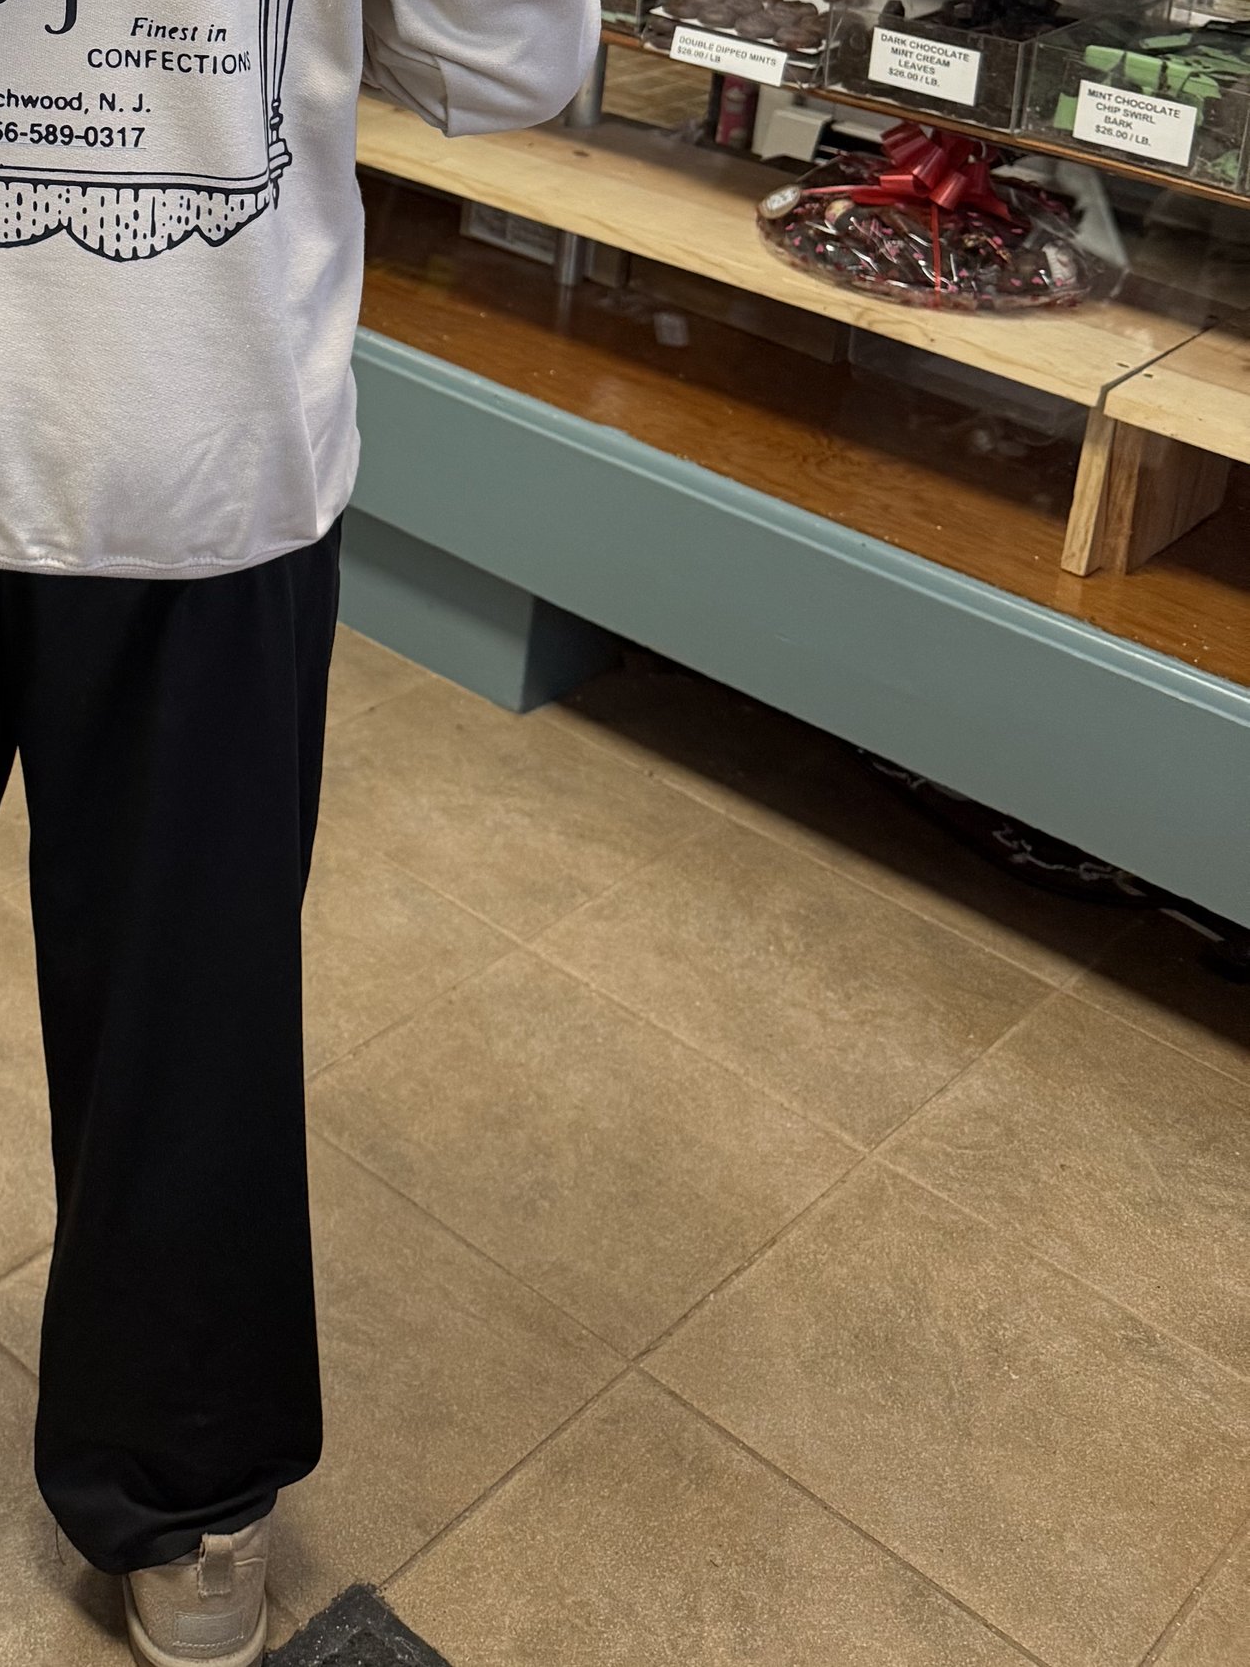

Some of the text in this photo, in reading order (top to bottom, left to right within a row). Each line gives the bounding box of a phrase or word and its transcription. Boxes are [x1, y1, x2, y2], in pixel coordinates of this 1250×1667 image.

[130, 17, 228, 42] Finest in
[679, 35, 777, 66] DOUBLE DIPPED MINTS
[880, 32, 970, 62] DARK CHOCOLATE
[890, 47, 951, 68] MINT CREAM
[87, 48, 251, 74] CONFECTIONS
[898, 59, 936, 75] LEAVES
[100, 92, 124, 112] N.
[132, 93, 152, 113] J.
[1087, 88, 1182, 119] MINT CHOCOLATE
[1096, 102, 1156, 125] CHIP SWIRL
[1104, 116, 1134, 130] BARK
